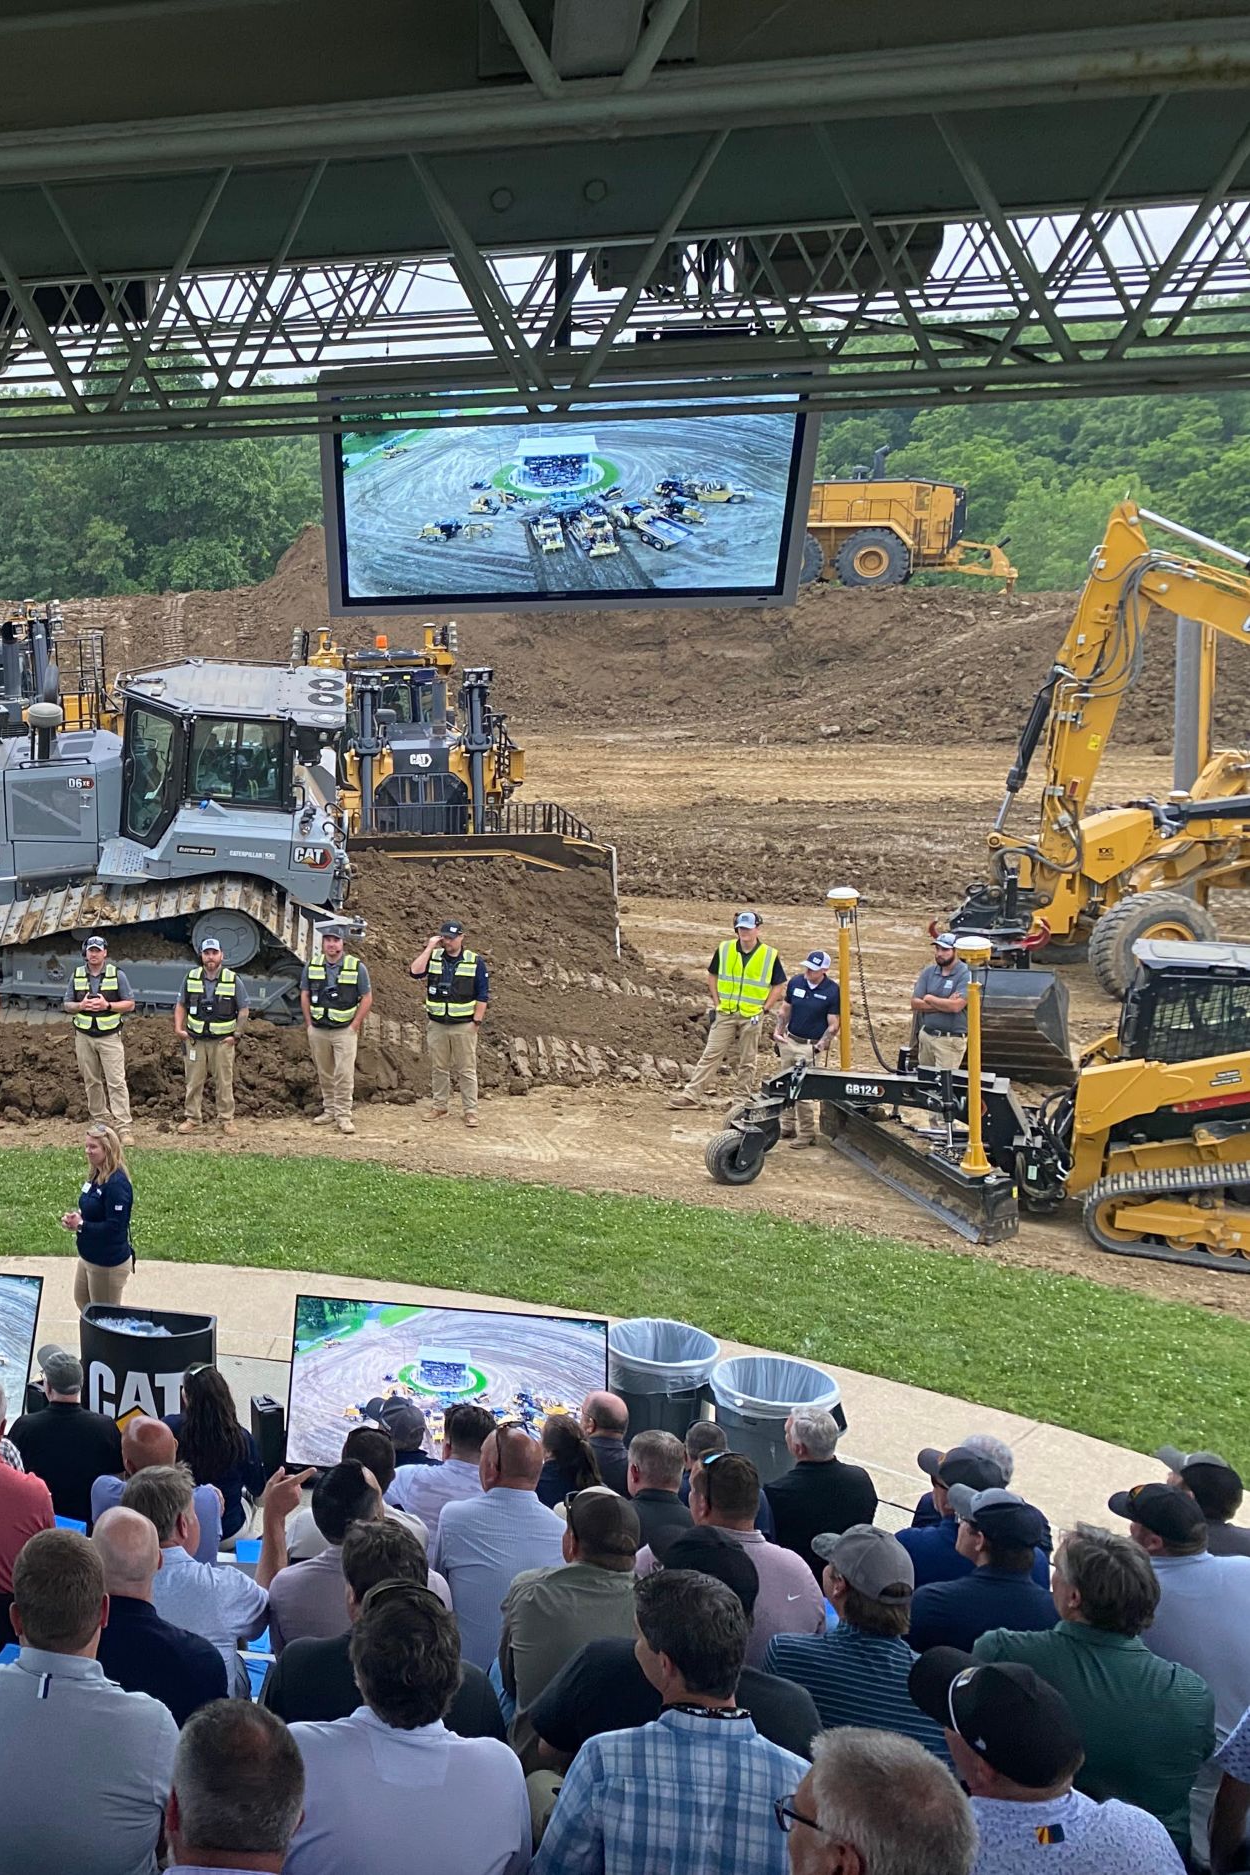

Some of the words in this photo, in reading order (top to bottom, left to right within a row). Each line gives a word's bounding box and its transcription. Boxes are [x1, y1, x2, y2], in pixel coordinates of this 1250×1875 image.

[409, 753, 432, 767] CAT
[294, 847, 325, 865] CAT
[845, 1083, 879, 1096] GB124
[89, 1360, 186, 1420] CAT
